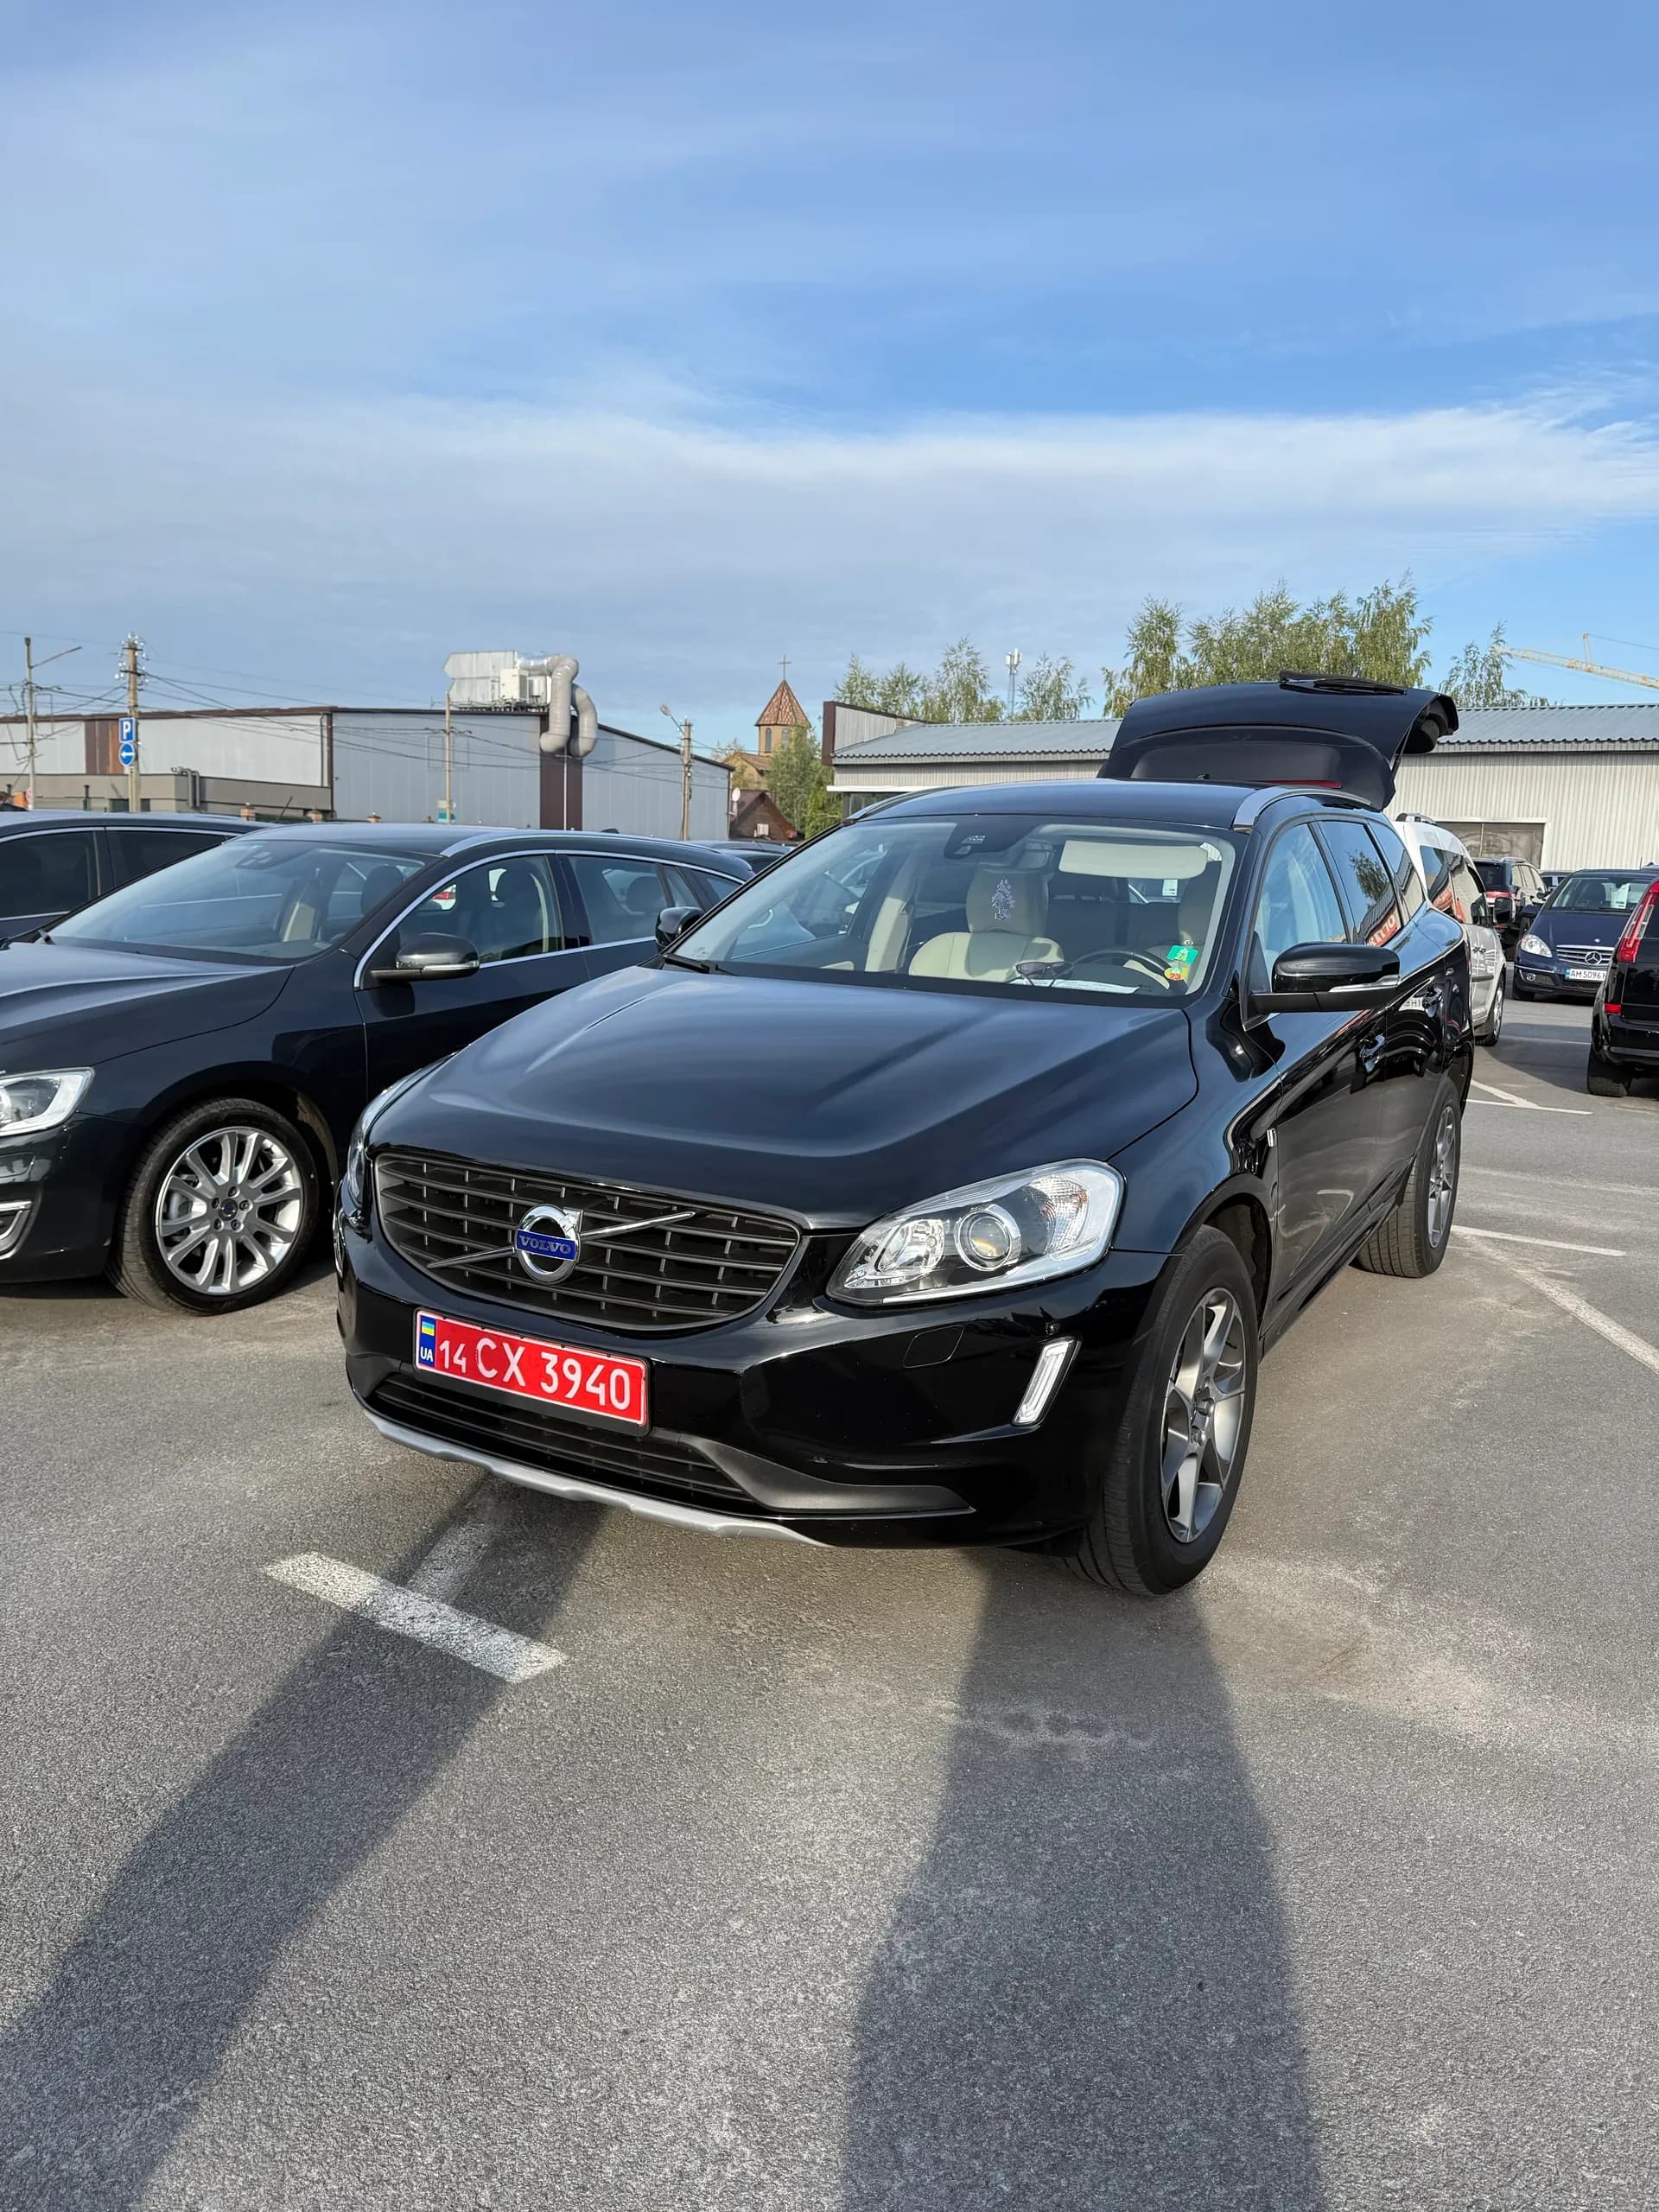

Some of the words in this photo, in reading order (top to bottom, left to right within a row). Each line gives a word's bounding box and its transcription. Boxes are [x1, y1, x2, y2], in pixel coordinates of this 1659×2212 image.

[123, 721, 131, 740] P
[518, 1235, 571, 1255] VOLVO
[420, 1345, 434, 1363] UA
[438, 1340, 467, 1374] 14
[476, 1337, 526, 1388] CX
[540, 1351, 631, 1411] 3940
